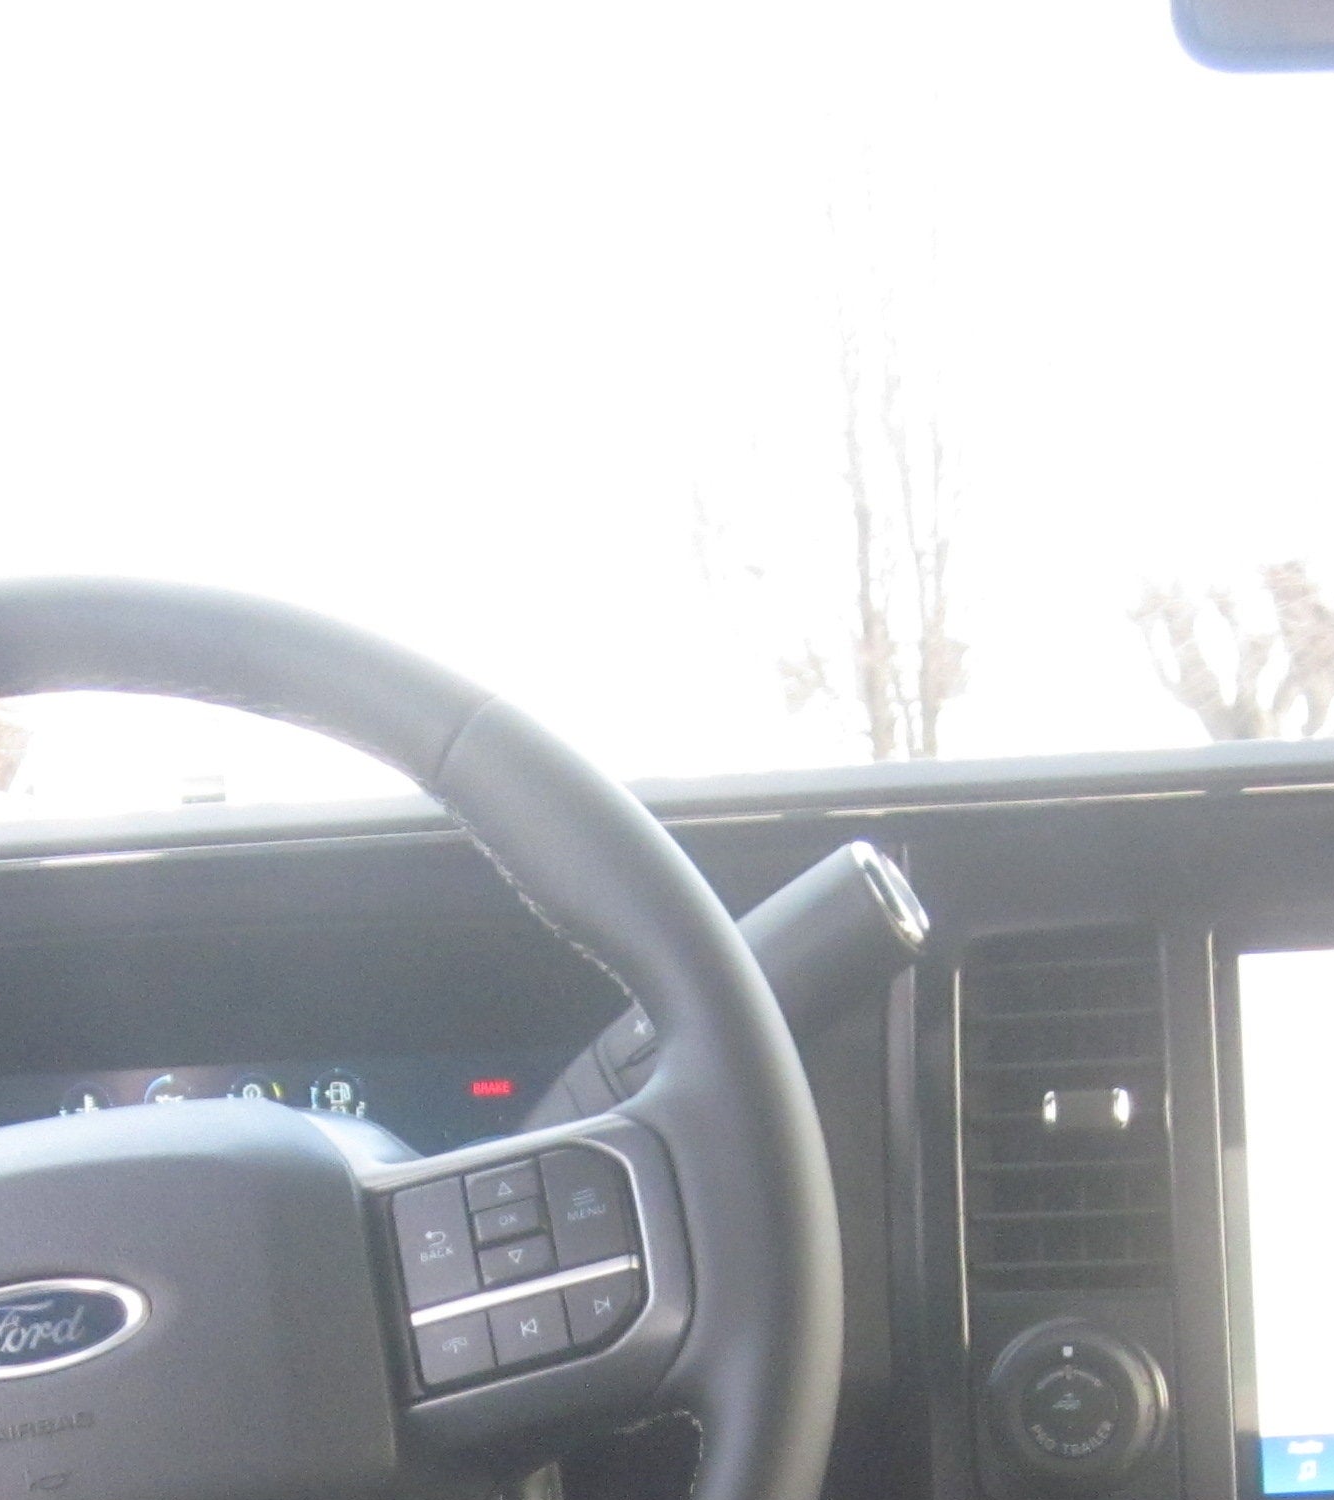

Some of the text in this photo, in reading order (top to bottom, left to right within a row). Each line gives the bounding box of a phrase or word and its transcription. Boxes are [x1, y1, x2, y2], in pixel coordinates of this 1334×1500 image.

[471, 1080, 511, 1096] BRAKE
[566, 1204, 606, 1222] MENU
[419, 1245, 455, 1264] BACK
